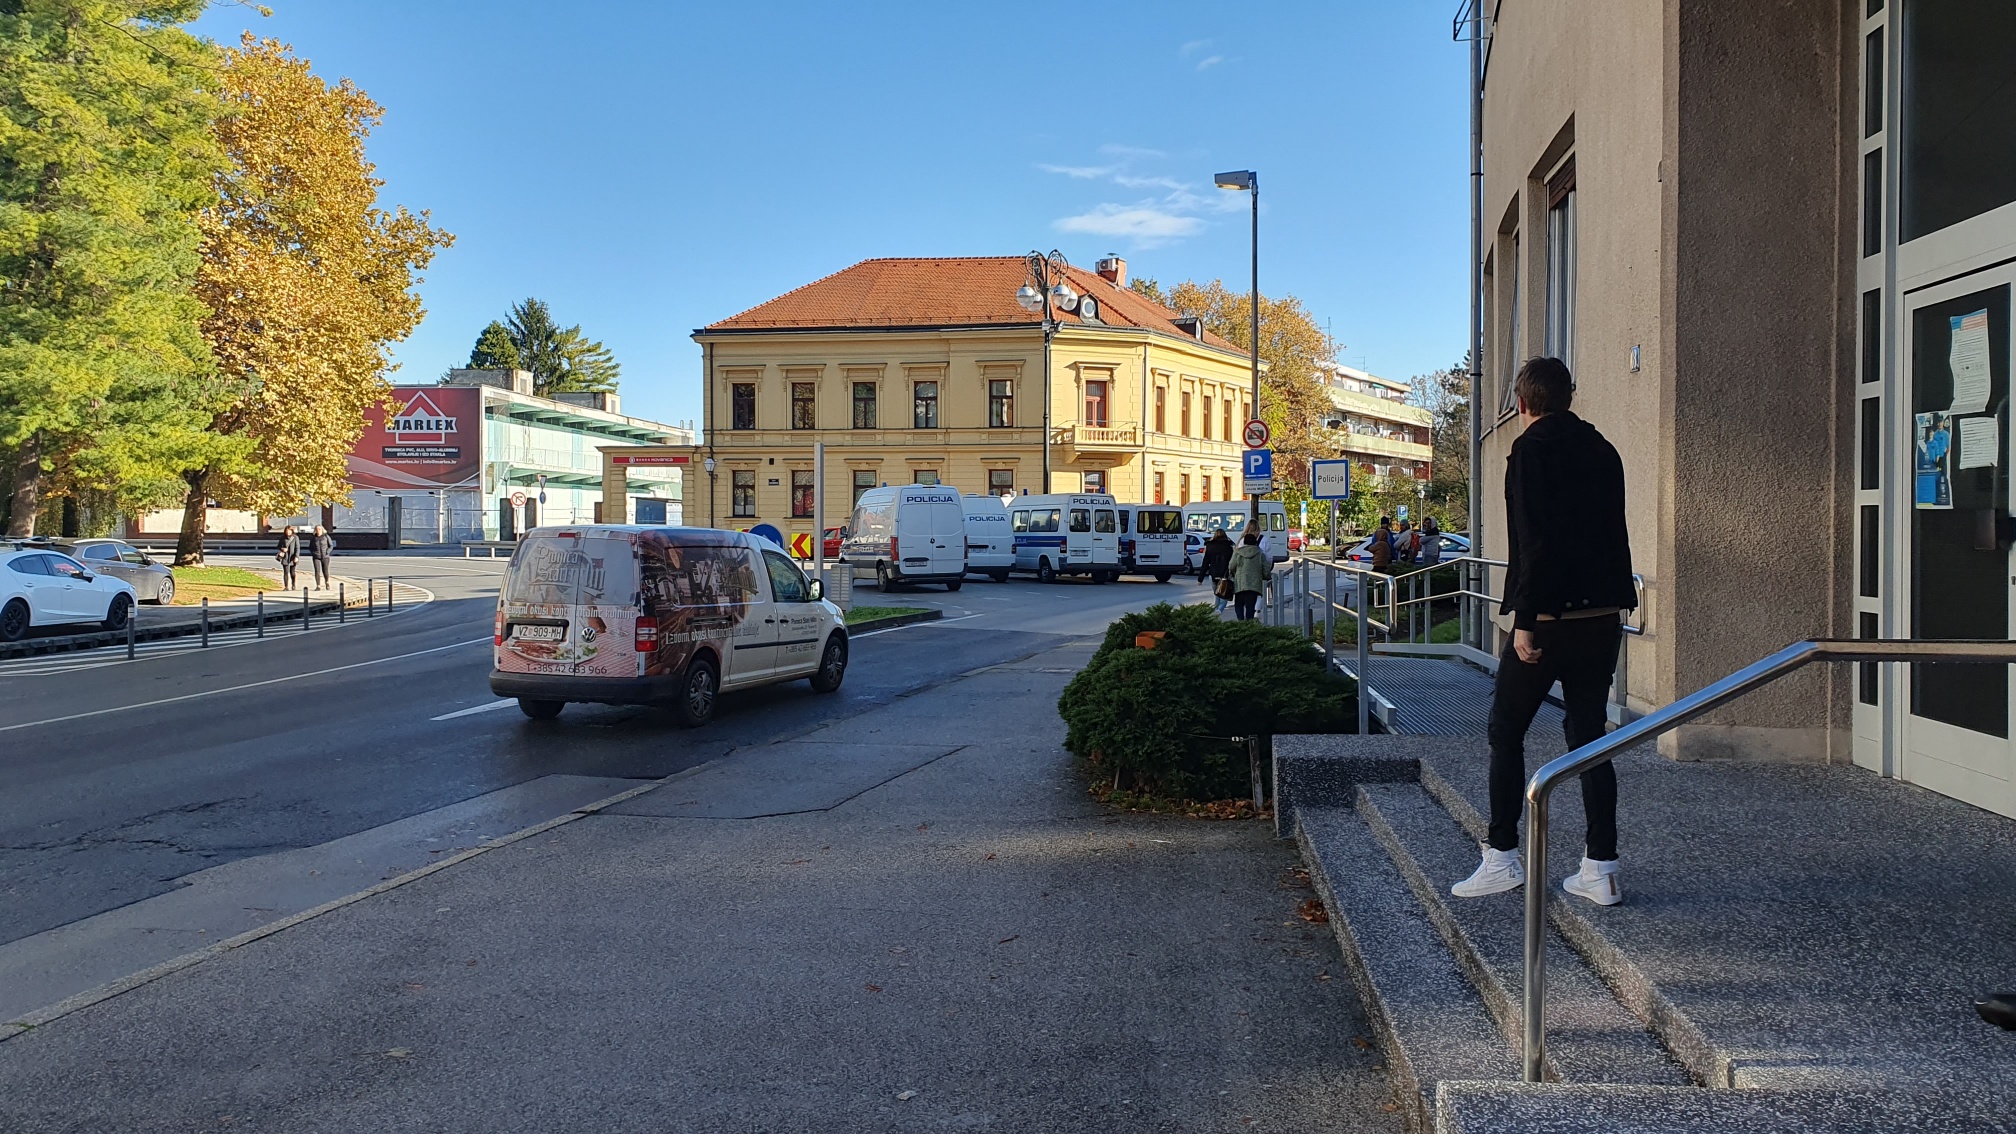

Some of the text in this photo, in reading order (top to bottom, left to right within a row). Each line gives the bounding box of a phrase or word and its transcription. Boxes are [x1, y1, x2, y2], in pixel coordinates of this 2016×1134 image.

[387, 419, 454, 431] MARLEX
[1251, 455, 1263, 474] P
[1317, 474, 1344, 484] Policija
[1072, 498, 1111, 506] POLICIJA
[519, 626, 561, 638] VZ 909-MH
[526, 663, 607, 674] T +385 42 683 966
